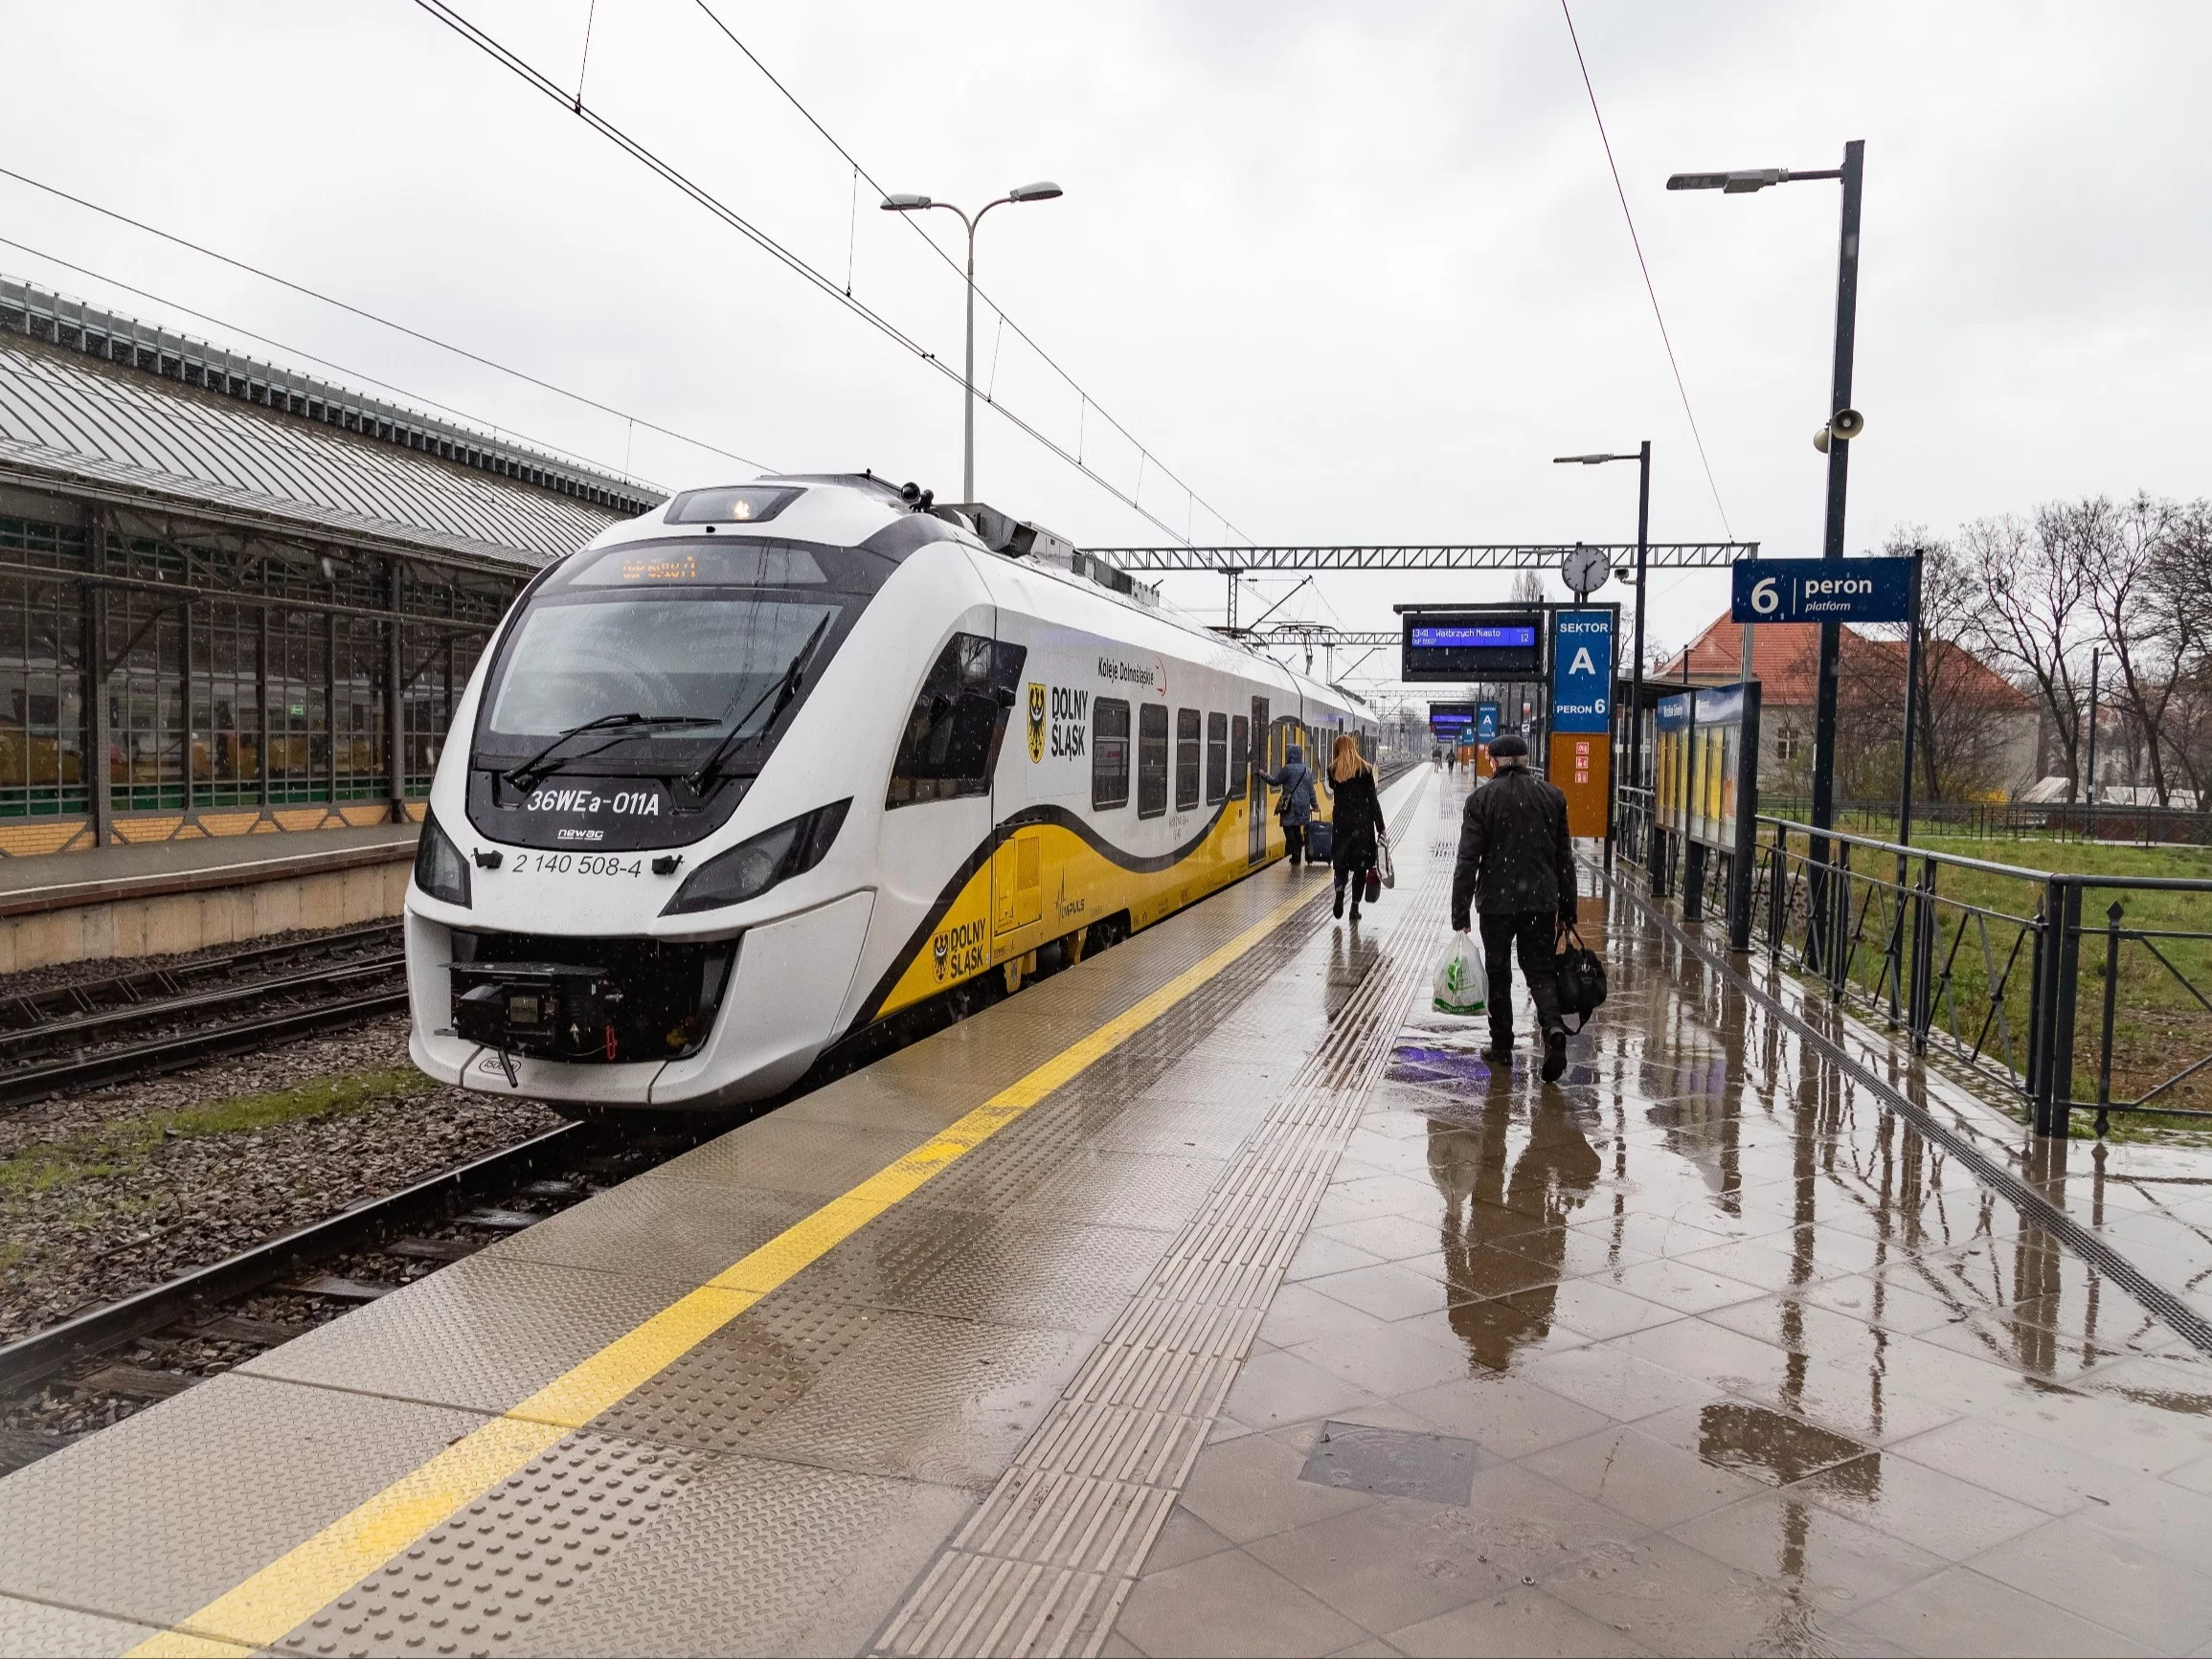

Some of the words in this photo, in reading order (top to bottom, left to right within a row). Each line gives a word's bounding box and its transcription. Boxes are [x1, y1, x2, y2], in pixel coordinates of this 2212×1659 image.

[1751, 577, 1779, 614] 6
[1805, 579, 1872, 598] peron
[1805, 600, 1851, 613] platform
[1476, 628, 1501, 638] Miasto
[1521, 633, 1529, 642] 12
[1560, 622, 1609, 633] SEKTOR
[1098, 656, 1118, 684] Koleje
[1119, 661, 1154, 688] Dolnośląskie
[1569, 647, 1596, 675] A
[1051, 686, 1089, 721] DOLNY
[1557, 705, 1592, 714] PERON
[1594, 699, 1606, 714] 6
[1483, 715, 1493, 726] A
[1050, 717, 1086, 761] ŚLĄSK
[528, 790, 659, 816] 36WEa-011A
[512, 854, 528, 873] 2
[535, 854, 573, 874] 140
[577, 856, 643, 878] 508-4
[950, 918, 986, 950] DOLNY
[950, 944, 983, 978] ŚLĄSK
